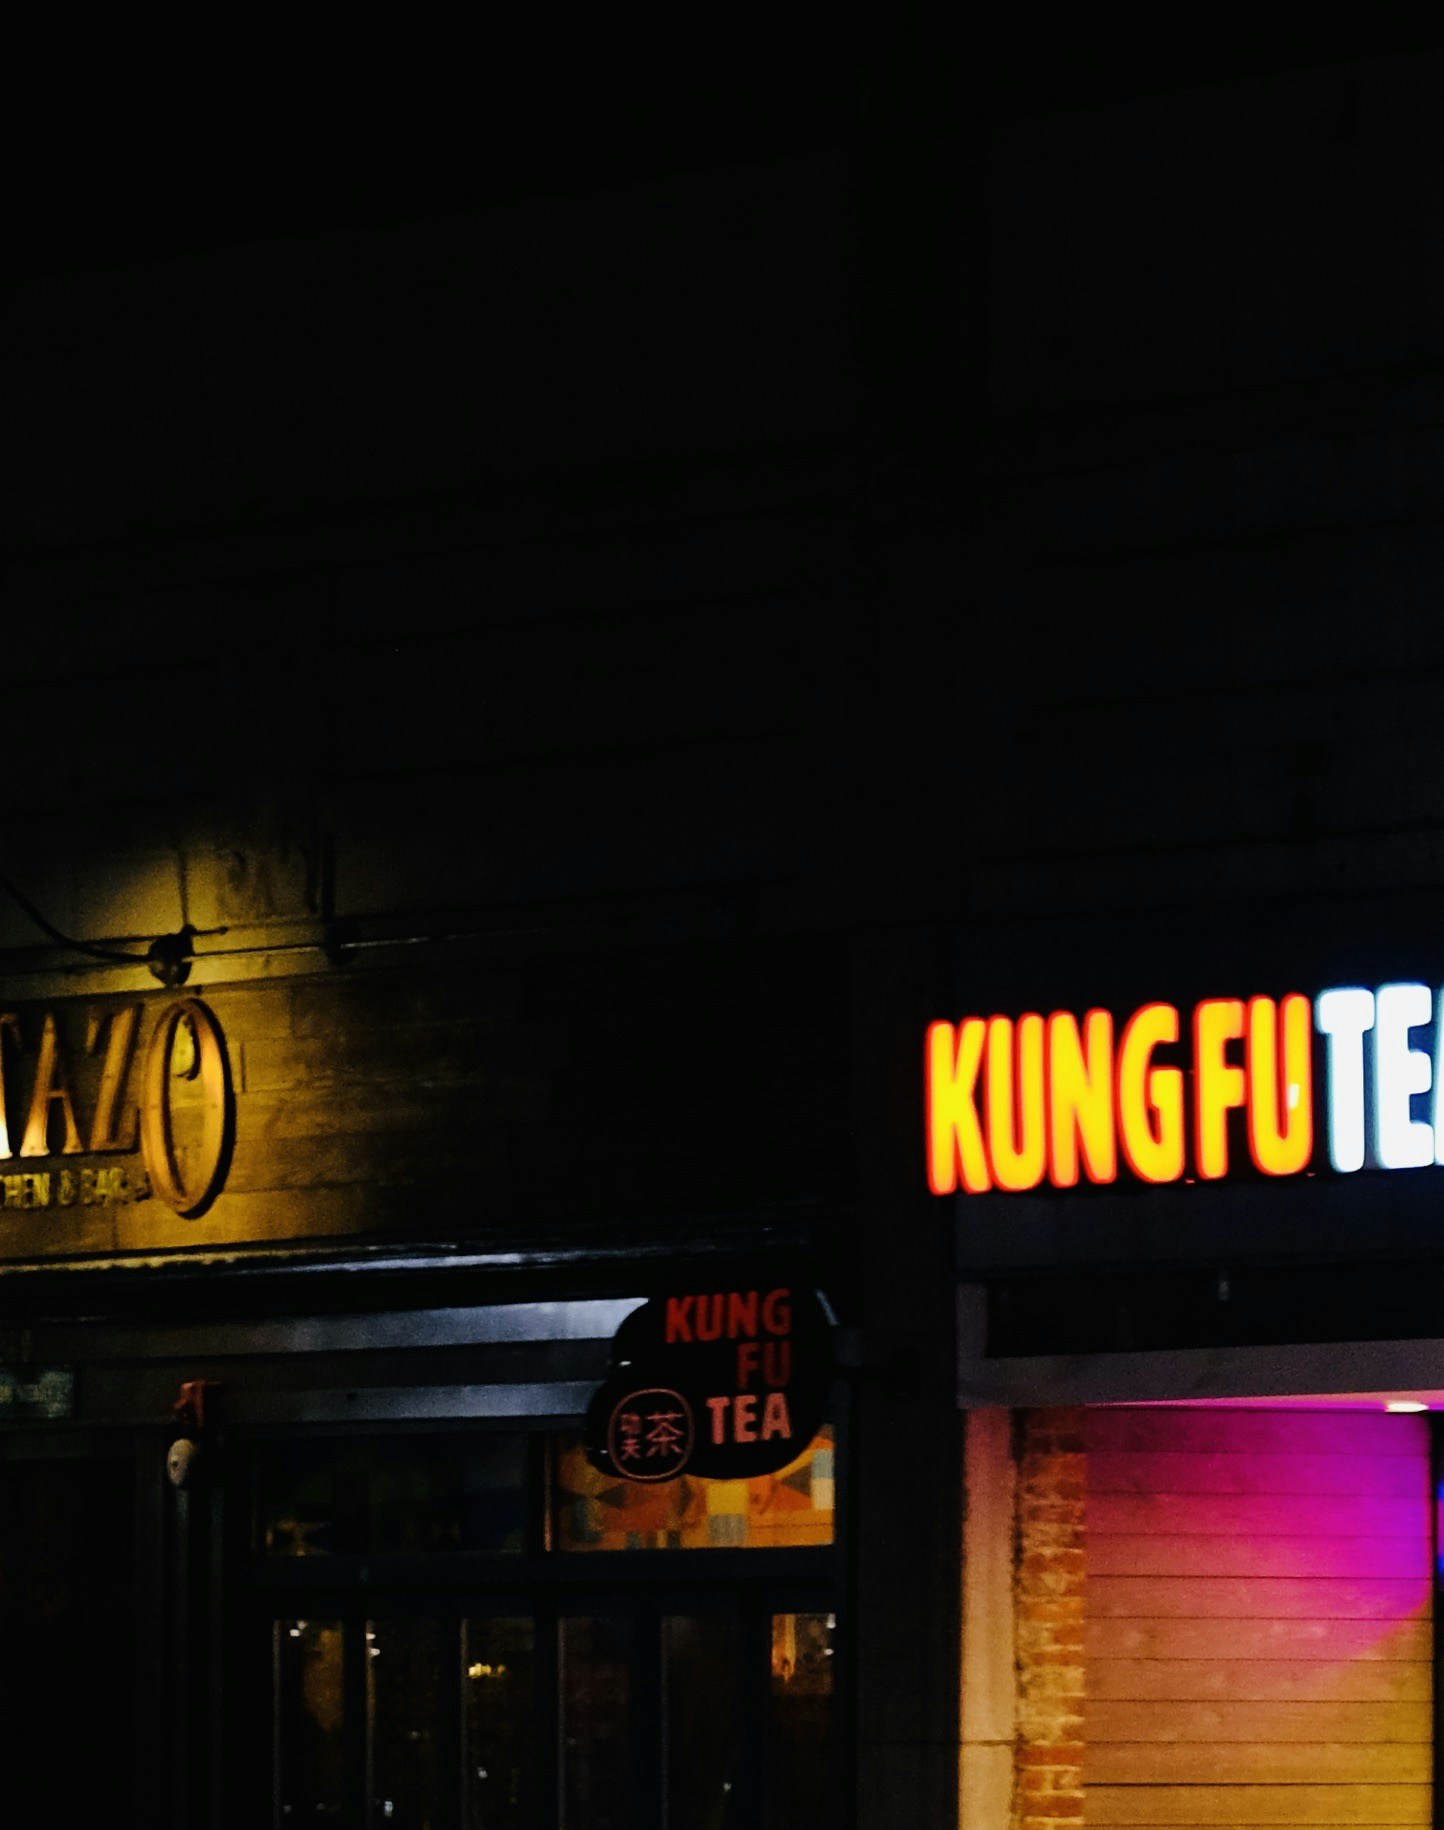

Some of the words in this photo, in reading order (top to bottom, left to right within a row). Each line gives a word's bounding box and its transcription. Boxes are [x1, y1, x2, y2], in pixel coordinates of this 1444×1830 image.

[926, 1002, 1185, 1195] KUNG
[1191, 993, 1313, 1180] FU
[0, 1169, 51, 1208] HEN
[664, 1287, 793, 1345] KUNG
[736, 1338, 792, 1391] FU
[704, 1391, 793, 1445] TEA
